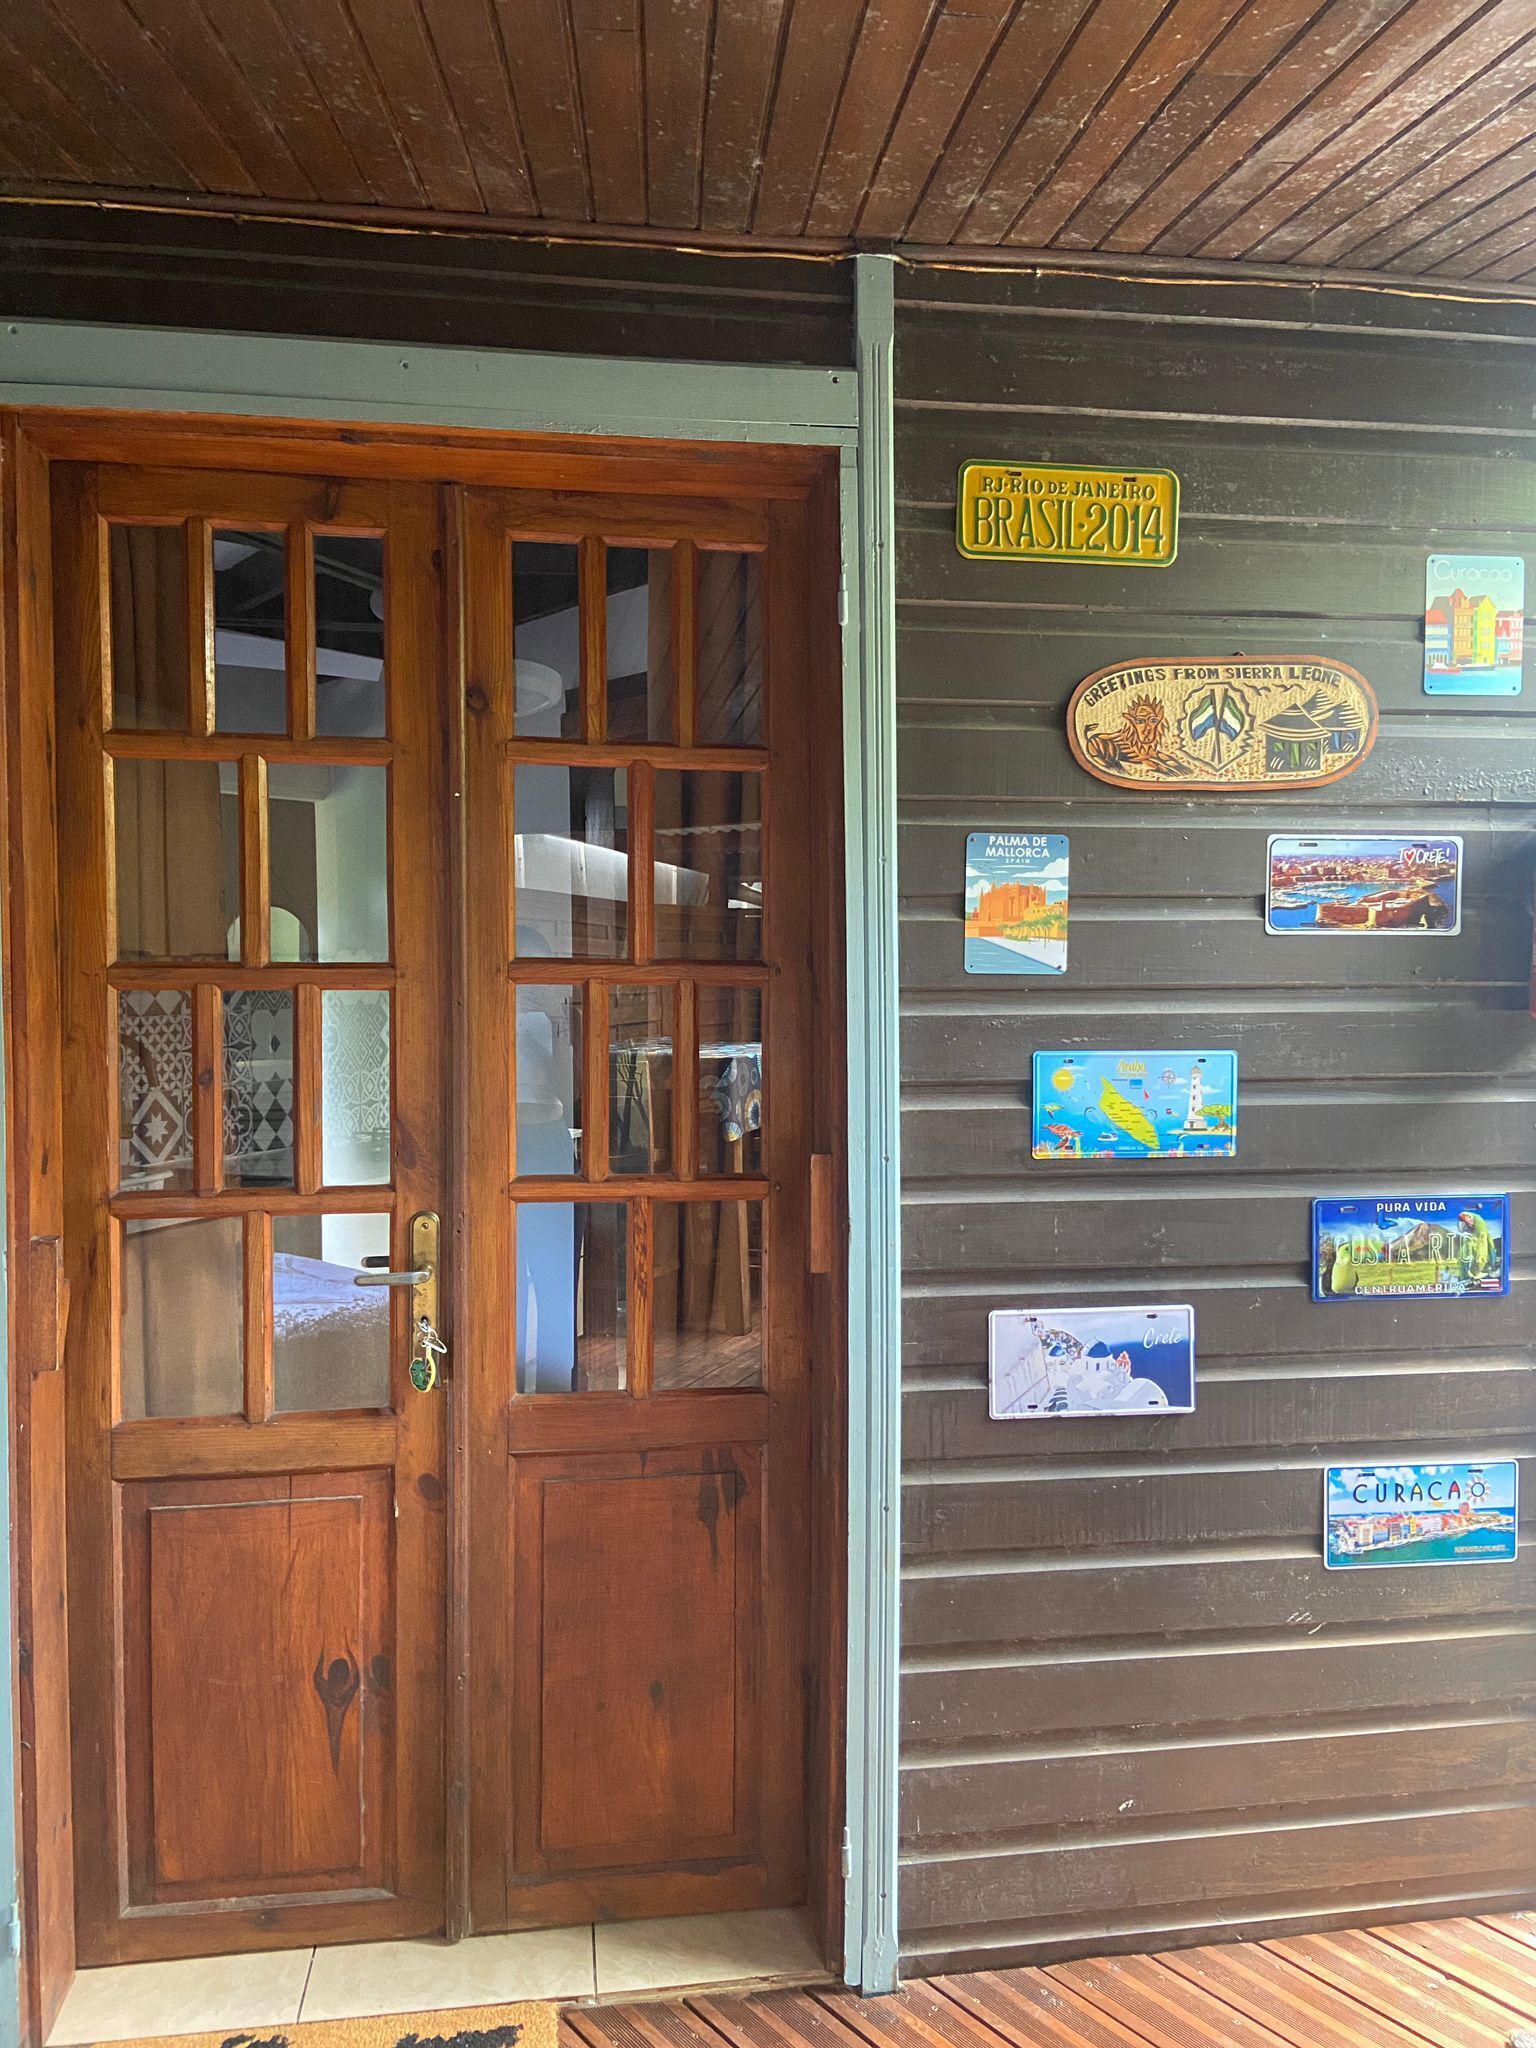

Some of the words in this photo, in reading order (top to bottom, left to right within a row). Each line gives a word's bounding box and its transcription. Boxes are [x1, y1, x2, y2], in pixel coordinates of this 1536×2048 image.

[1048, 480, 1067, 494] DE
[1072, 481, 1155, 500] JANEIRO
[1084, 668, 1165, 706] GREETINGS
[1174, 668, 1219, 680] FROM
[1227, 667, 1282, 680] SIERRA
[1289, 667, 1341, 689] LEONE
[989, 836, 1029, 846] PALMA
[1033, 837, 1047, 846] DE
[985, 847, 1049, 858] MALLORCA
[1117, 1059, 1147, 1072] Aruba
[1376, 1203, 1410, 1213] PURA
[1416, 1202, 1446, 1212] VIDA
[1355, 1283, 1466, 1294] CENTROAMERICA
[1143, 1326, 1183, 1348] Crete
